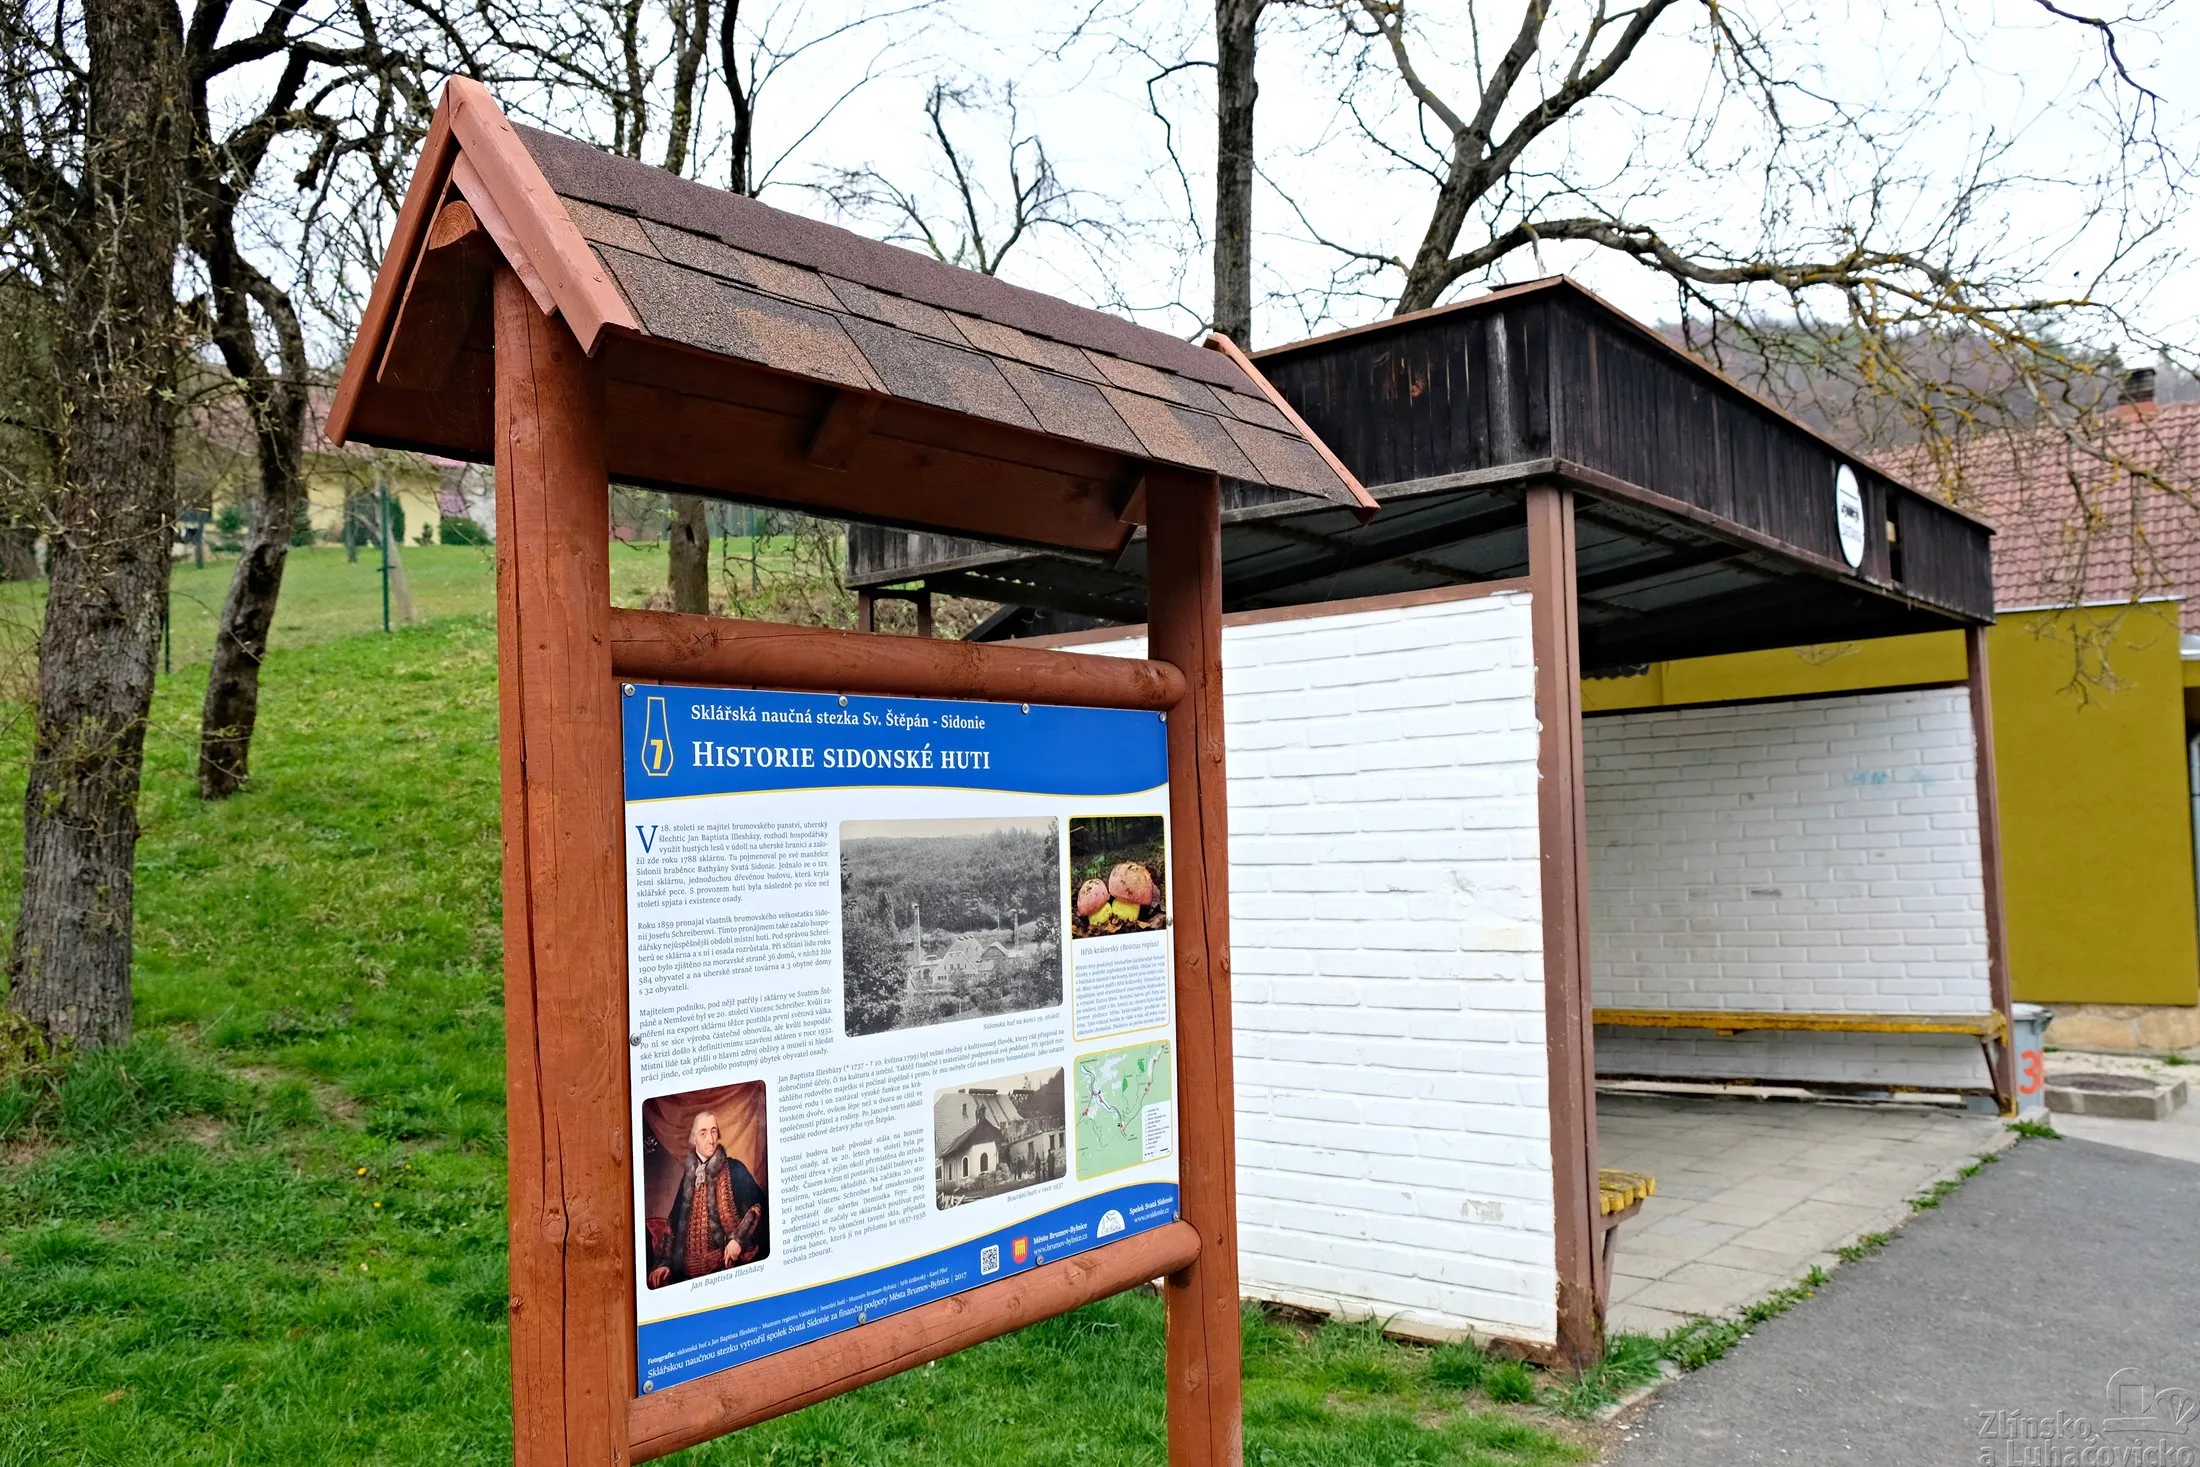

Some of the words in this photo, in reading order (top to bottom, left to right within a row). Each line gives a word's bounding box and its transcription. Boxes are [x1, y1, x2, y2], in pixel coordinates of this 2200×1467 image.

[691, 704, 756, 721] Sklářská
[761, 708, 812, 723] naučná
[816, 710, 859, 725] stezka
[862, 711, 881, 725] Sv.
[885, 709, 928, 730] Štěpán
[941, 714, 985, 729] Sidonie
[650, 739, 664, 770] 7
[658, 834, 685, 842] šlechtic
[701, 833, 729, 842] Baptista
[731, 833, 762, 841] Illesházy,
[789, 831, 828, 840] hospodářsky
[672, 823, 695, 831] století
[706, 823, 730, 832] majitel
[776, 821, 802, 830] panství,
[803, 821, 828, 829] uherský
[635, 825, 658, 854] V
[658, 845, 680, 854] využít
[681, 844, 709, 853] hustých
[680, 855, 697, 864] 1788
[698, 854, 726, 862] sklárnu.
[739, 852, 776, 862] pojmenoval
[800, 850, 828, 858] manželce
[636, 867, 661, 875] Sidonii
[663, 866, 695, 874] hraběnce
[697, 865, 728, 874] Bathyány
[730, 863, 749, 871] Svatá
[750, 862, 776, 870] Sidonie.
[778, 861, 802, 869] Jednalo
[636, 878, 654, 886] lesní
[656, 877, 685, 885] sklárnu,
[687, 875, 731, 885] jednoduchou
[734, 873, 764, 881] dřevěnou
[813, 870, 829, 878] kryla
[636, 888, 666, 897] sklářské
[669, 889, 687, 897] pece.
[696, 886, 729, 895] provozem
[747, 883, 761, 892] byla
[764, 881, 792, 890] následně
[794, 882, 802, 890] po
[637, 899, 659, 908] století
[661, 899, 682, 908] spjata
[722, 895, 743, 903] osady.
[638, 921, 655, 929] Roku
[657, 920, 674, 929] 1859
[675, 917, 704, 928] pronajal
[705, 915, 732, 924] vlastník
[733, 912, 777, 922] brumovského
[778, 910, 813, 919] velkostatku
[637, 932, 647, 940] nii
[647, 931, 670, 939] Josefu
[671, 927, 716, 937] Schreiberovi.
[716, 926, 737, 934] Tímto
[738, 924, 775, 934] pronájmem
[775, 921, 789, 929] také
[790, 920, 809, 928] začalo
[637, 942, 661, 951] dářsky
[663, 938, 709, 950] nejúspěšnější
[710, 936, 732, 945] období
[733, 934, 754, 943] místní
[755, 933, 768, 941] huti.
[784, 931, 808, 940] správou
[639, 1006, 675, 1017] Majitelem
[676, 1002, 706, 1014] podniku,
[707, 1000, 720, 1010] pod
[721, 998, 735, 1007] nějž
[736, 996, 758, 1006] patřily
[763, 993, 787, 1001] sklárny
[796, 989, 819, 997] Svatém
[639, 1018, 657, 1029] páně
[663, 1013, 695, 1024] Nemšové
[695, 1012, 706, 1022] byl
[728, 1007, 749, 1016] století
[749, 1005, 774, 1013] Vincenc
[775, 1001, 806, 1010] Schreiber.
[807, 998, 823, 1006] Kvůli
[1129, 1203, 1144, 1215] Spolek
[1144, 1200, 1156, 1210] Svatá
[1157, 1195, 1173, 1206] Sidonie
[1033, 1234, 1048, 1244] Město
[1049, 1222, 1087, 1239] Brumov-Bylnice
[689, 1281, 703, 1290] Jan
[704, 1273, 733, 1285] Baptista
[734, 1264, 764, 1277] Illesházy
[647, 1361, 683, 1378] Sklářskou
[685, 1351, 715, 1366] naučnou
[716, 1343, 738, 1356] stezku
[739, 1333, 765, 1350] vytvořil
[766, 1326, 787, 1341] spolek
[788, 1320, 805, 1334] Svatá
[806, 1314, 829, 1328] Sidonie
[830, 1312, 838, 1320] za
[838, 1303, 863, 1318] finanční
[863, 1297, 888, 1311] podpory
[889, 1291, 906, 1302] Města
[906, 1277, 949, 1296] Brumov-Bylnice
[954, 1272, 967, 1281] 2017
